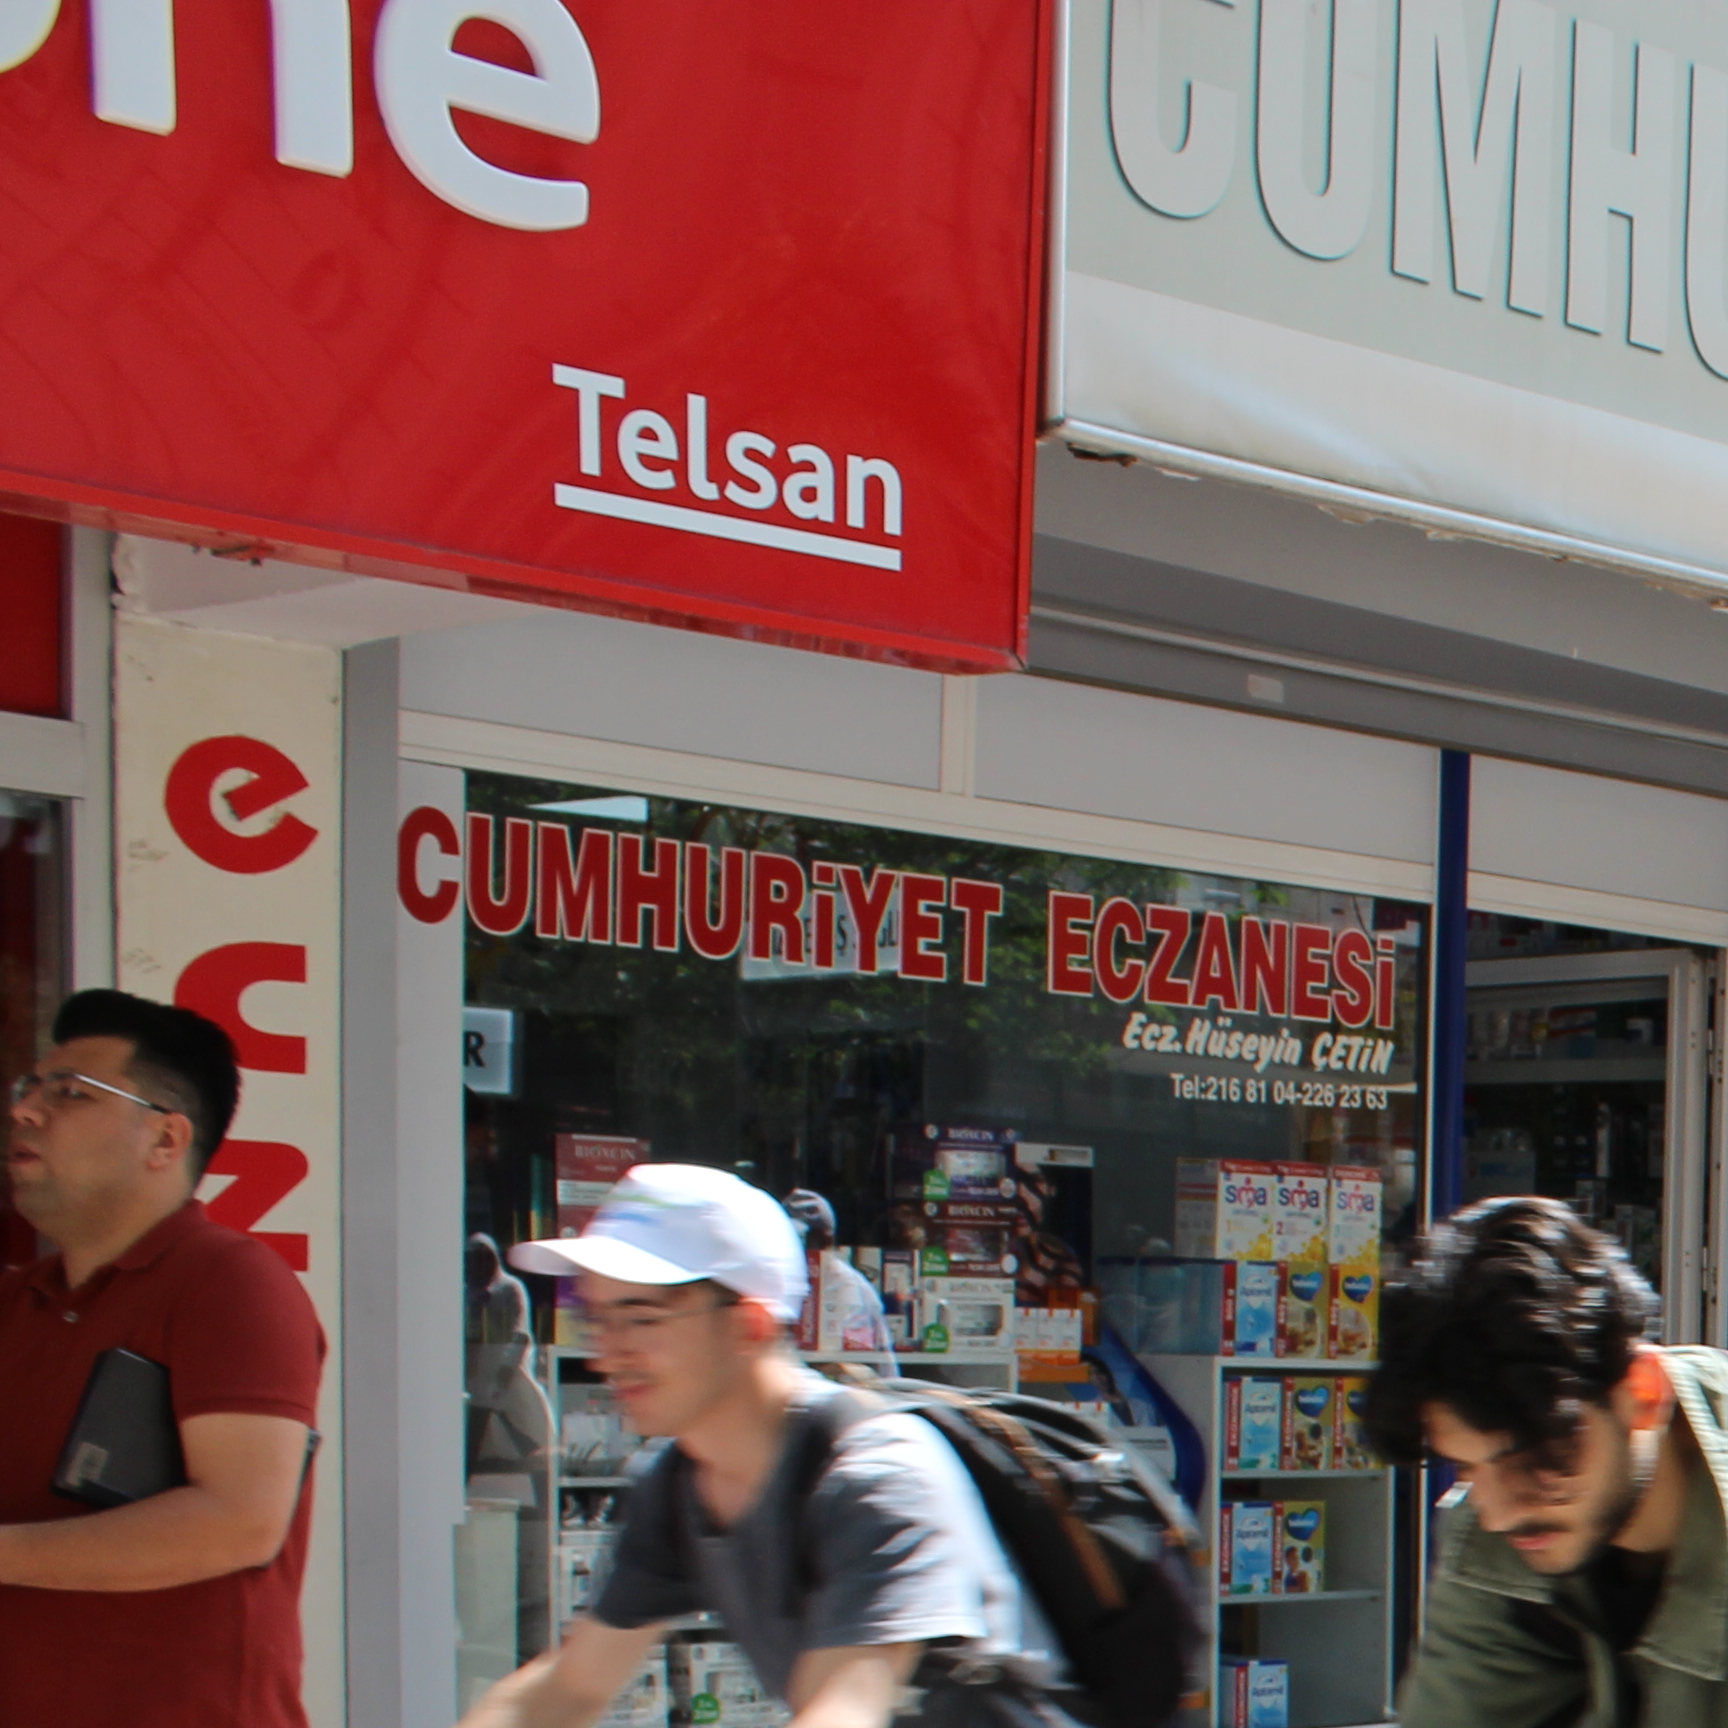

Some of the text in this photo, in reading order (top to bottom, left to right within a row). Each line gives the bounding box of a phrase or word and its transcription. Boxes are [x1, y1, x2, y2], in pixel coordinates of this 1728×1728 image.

[551, 362, 902, 535] Telsan
[1047, 888, 1396, 1031] ECZANESİ
[1184, 1015, 1303, 1074] Hüseyin
[1310, 1031, 1395, 1076] ÇETİN
[1170, 1072, 1241, 1103] Tel:216
[1244, 1078, 1267, 1104] 81
[1339, 1084, 1361, 1110] 23
[1223, 1181, 1267, 1209] sma
[1276, 1184, 1319, 1210] sma
